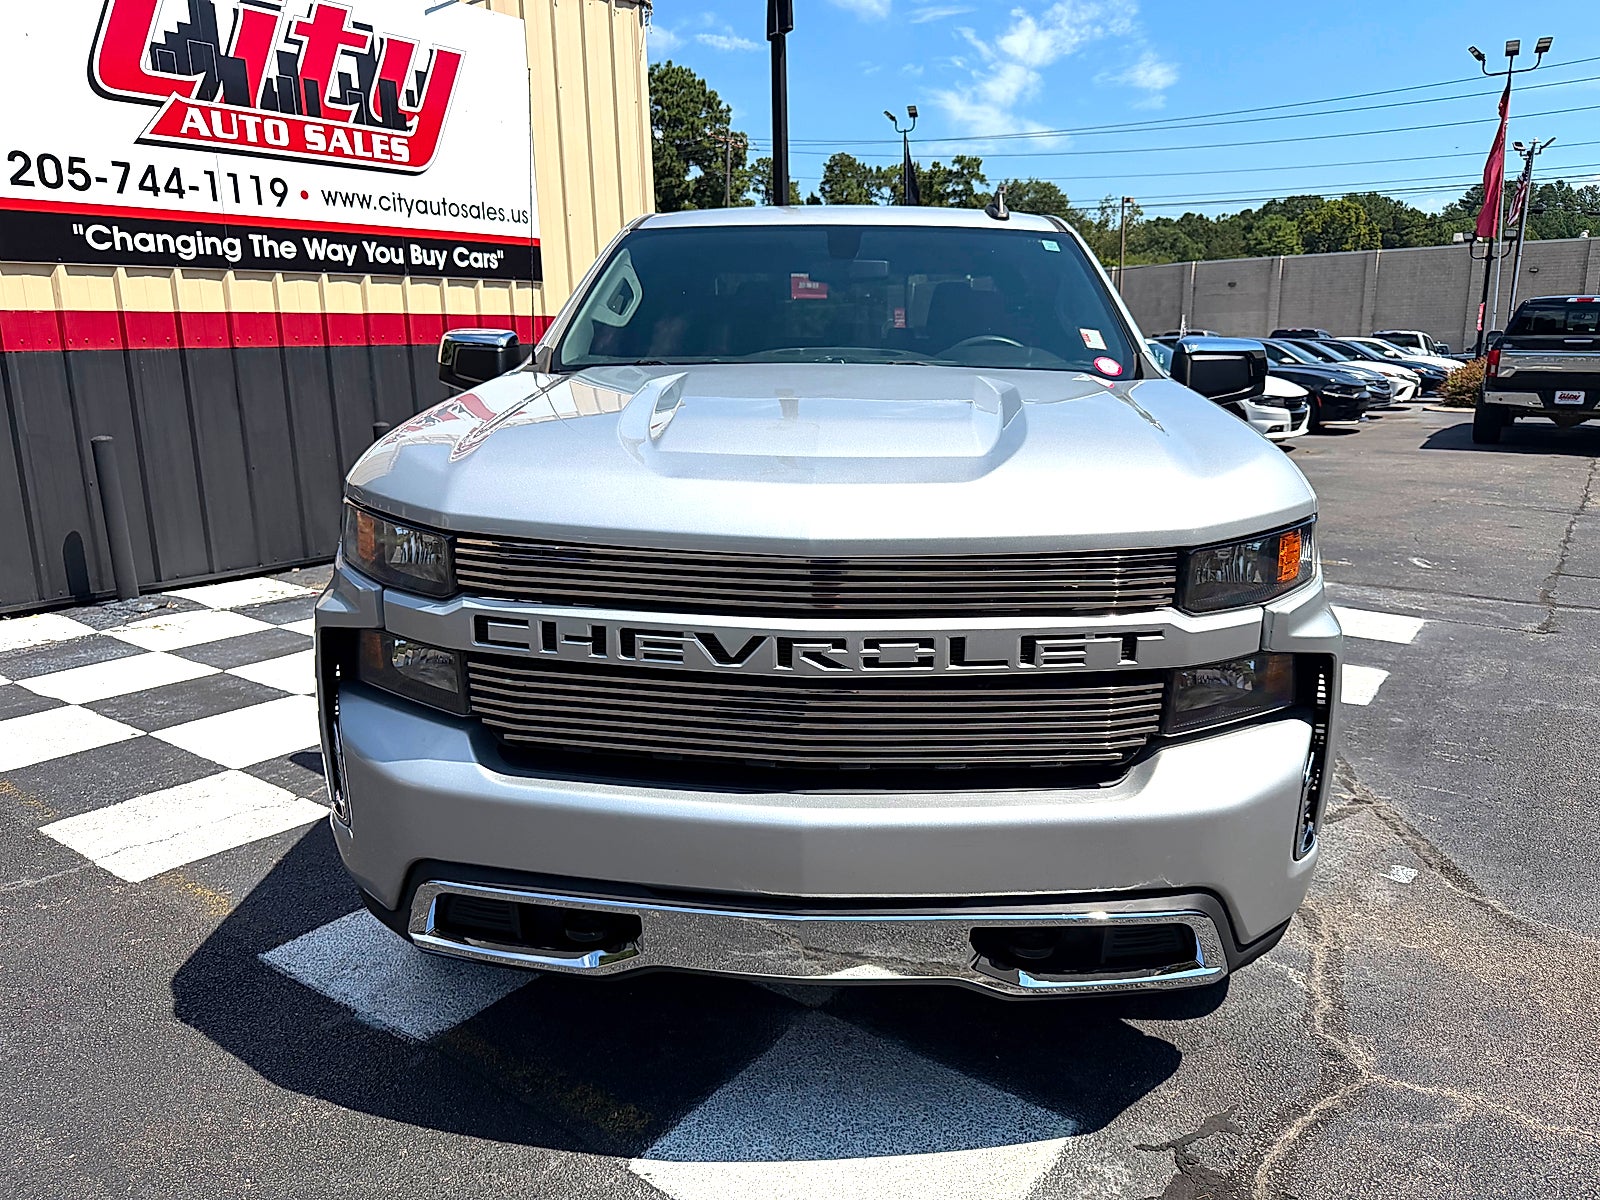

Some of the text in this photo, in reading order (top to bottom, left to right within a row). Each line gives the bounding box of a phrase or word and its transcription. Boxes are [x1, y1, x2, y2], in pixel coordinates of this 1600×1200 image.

[180, 107, 410, 163] AUTO SALES
[7, 150, 529, 224] 205-744-1119 www.cityautosales.us
[72, 223, 504, 270] "Changing The Way You Buy Cars"
[471, 613, 1166, 672] CHEVROLET
